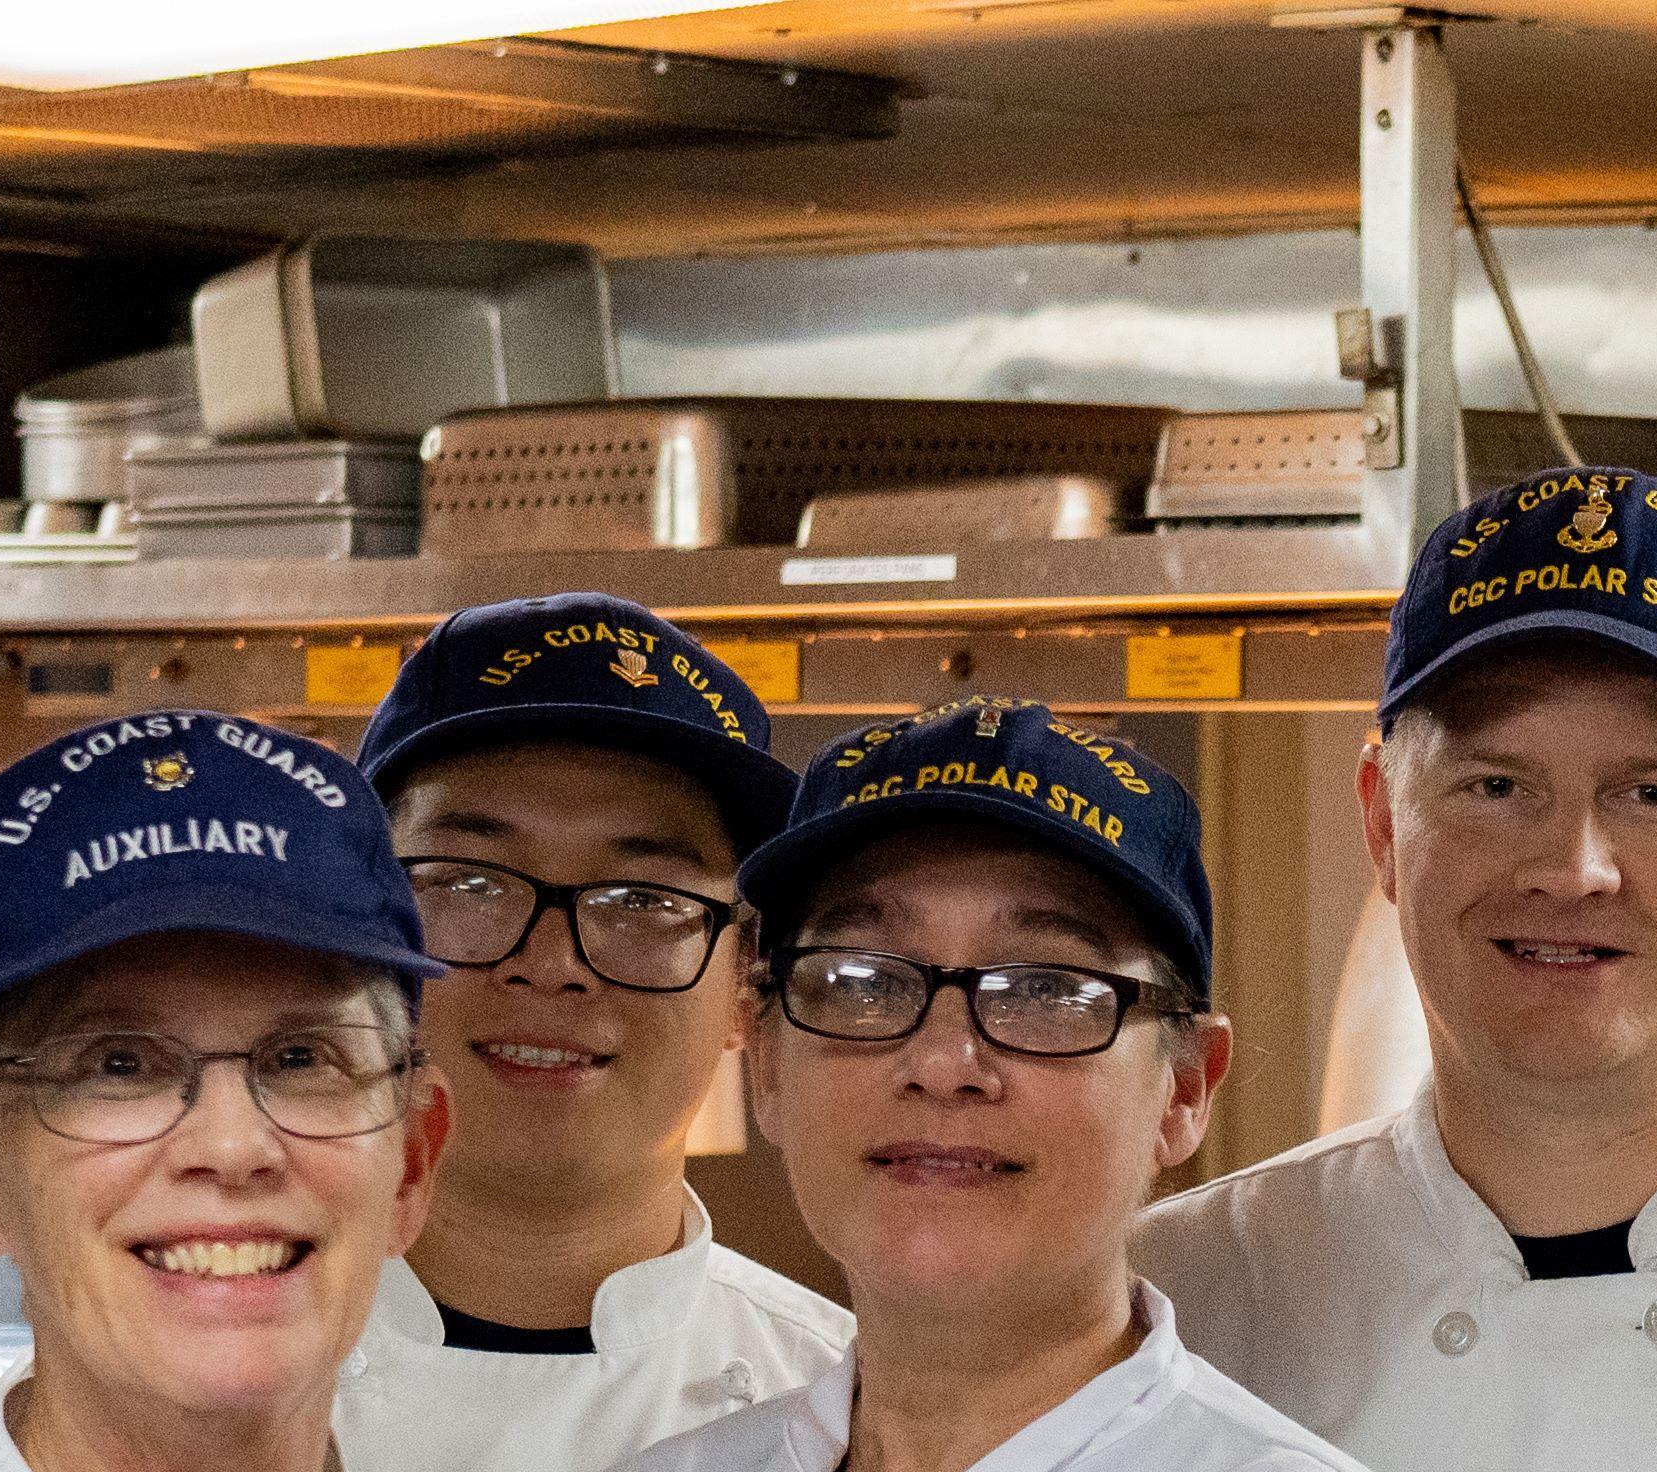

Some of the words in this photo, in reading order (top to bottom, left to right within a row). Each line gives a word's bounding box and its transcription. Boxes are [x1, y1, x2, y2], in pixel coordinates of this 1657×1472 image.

[1450, 517, 1510, 558] U.S.
[1518, 474, 1634, 512] COAST
[1449, 576, 1509, 617] CGC
[1515, 563, 1628, 596] POLAR
[479, 649, 542, 686] U.S.
[544, 622, 659, 653] COAST
[61, 714, 198, 773] COAST
[216, 723, 347, 808] GUARD
[1047, 722, 1151, 795] GUARD
[916, 762, 1038, 798] POLAR
[1047, 784, 1124, 847] STAR
[63, 818, 291, 888] AUXILIARY
